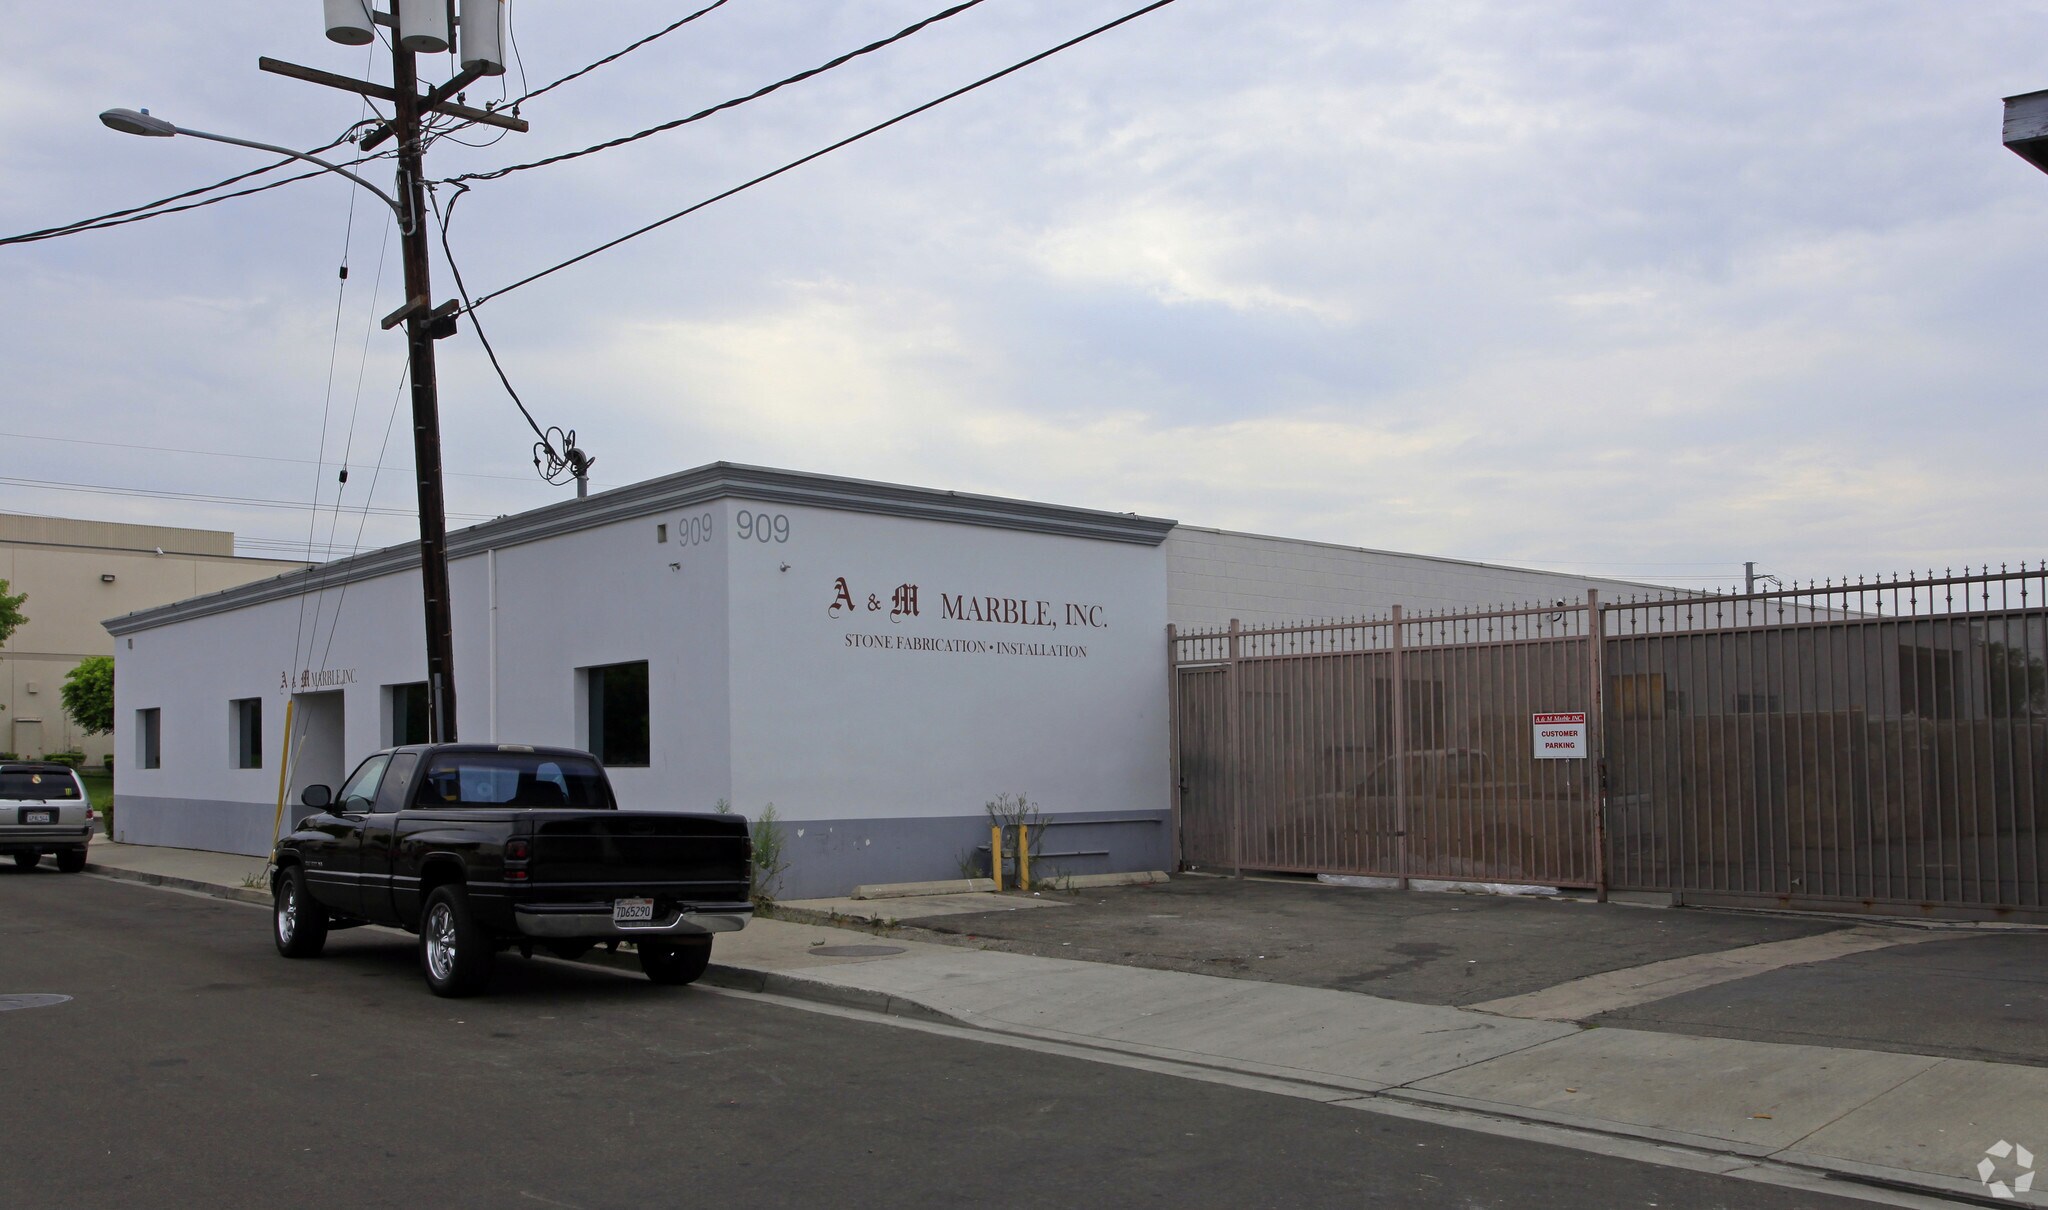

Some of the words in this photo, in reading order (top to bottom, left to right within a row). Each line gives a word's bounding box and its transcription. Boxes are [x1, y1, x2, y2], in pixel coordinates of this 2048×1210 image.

[679, 513, 712, 547] 909
[736, 510, 790, 543] 909
[828, 576, 856, 619] A
[867, 593, 881, 611] &
[890, 583, 920, 623] M
[941, 593, 1057, 630] MARBLE,
[1065, 603, 1108, 628] INC.
[845, 633, 892, 649] STONE
[616, 906, 651, 917] 7D65290
